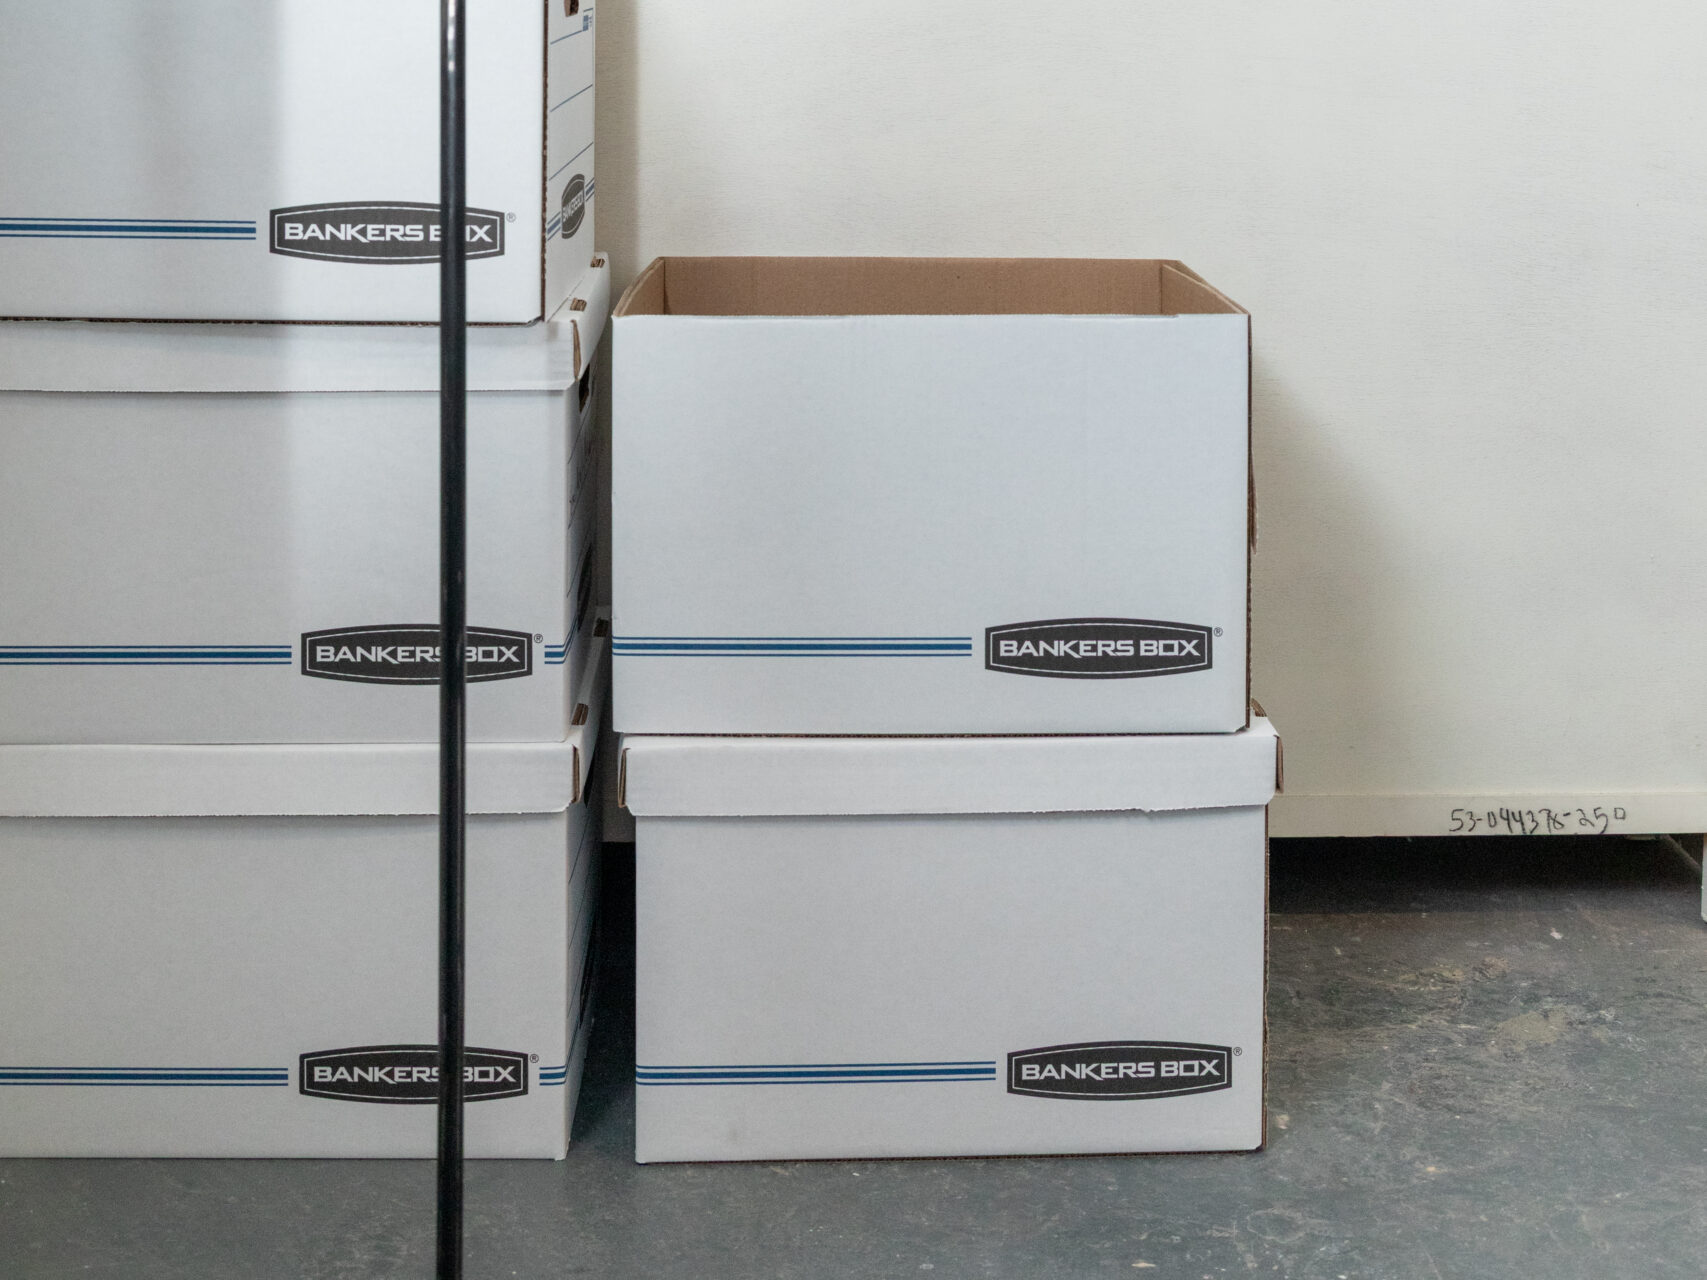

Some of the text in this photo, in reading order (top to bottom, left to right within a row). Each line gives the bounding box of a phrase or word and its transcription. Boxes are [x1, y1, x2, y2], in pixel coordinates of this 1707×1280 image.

[284, 223, 493, 243] BANKERS BX
[1000, 639, 1201, 659] BANKERS BOX
[1021, 1059, 1221, 1081] BANKERS BOX
